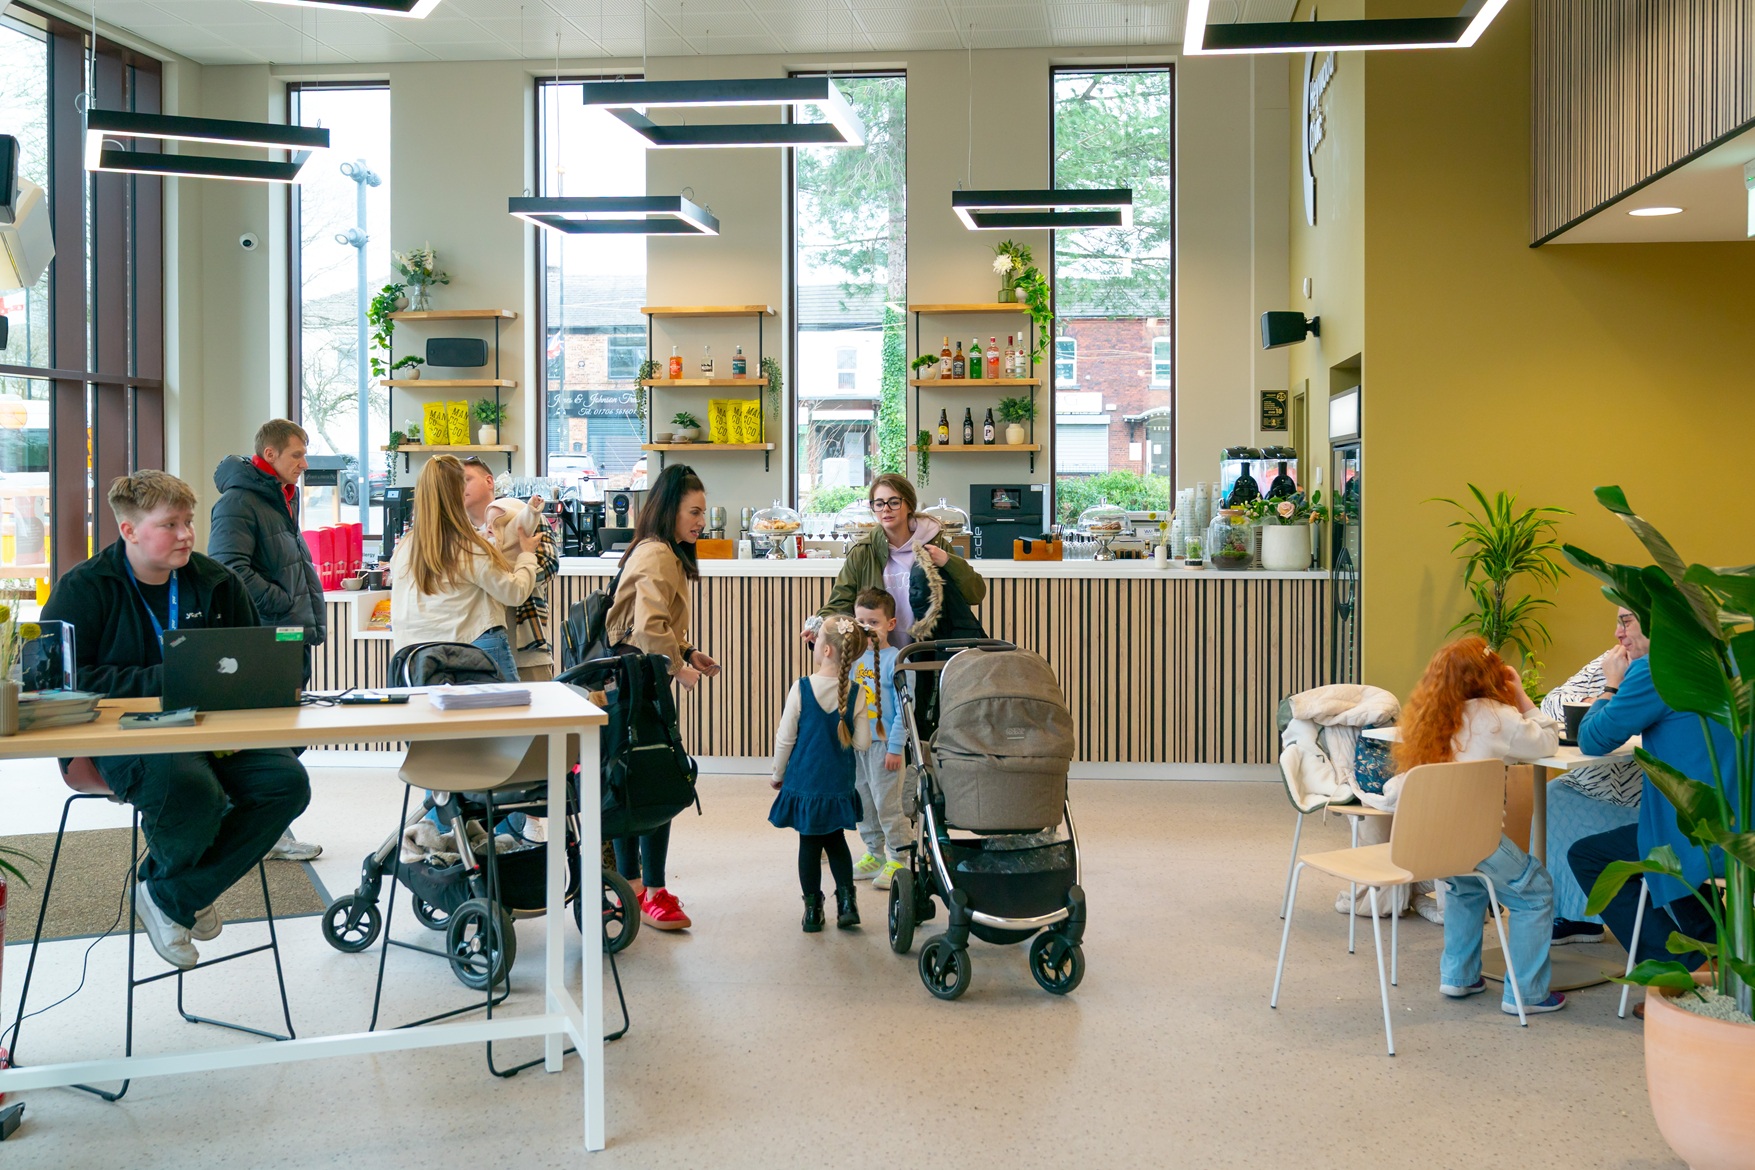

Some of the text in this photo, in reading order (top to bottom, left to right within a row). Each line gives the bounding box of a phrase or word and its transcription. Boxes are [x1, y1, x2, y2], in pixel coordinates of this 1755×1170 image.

[547, 393, 573, 407] Jnes
[574, 393, 583, 404] &
[583, 393, 618, 407] Johnson
[972, 526, 983, 560] racle
